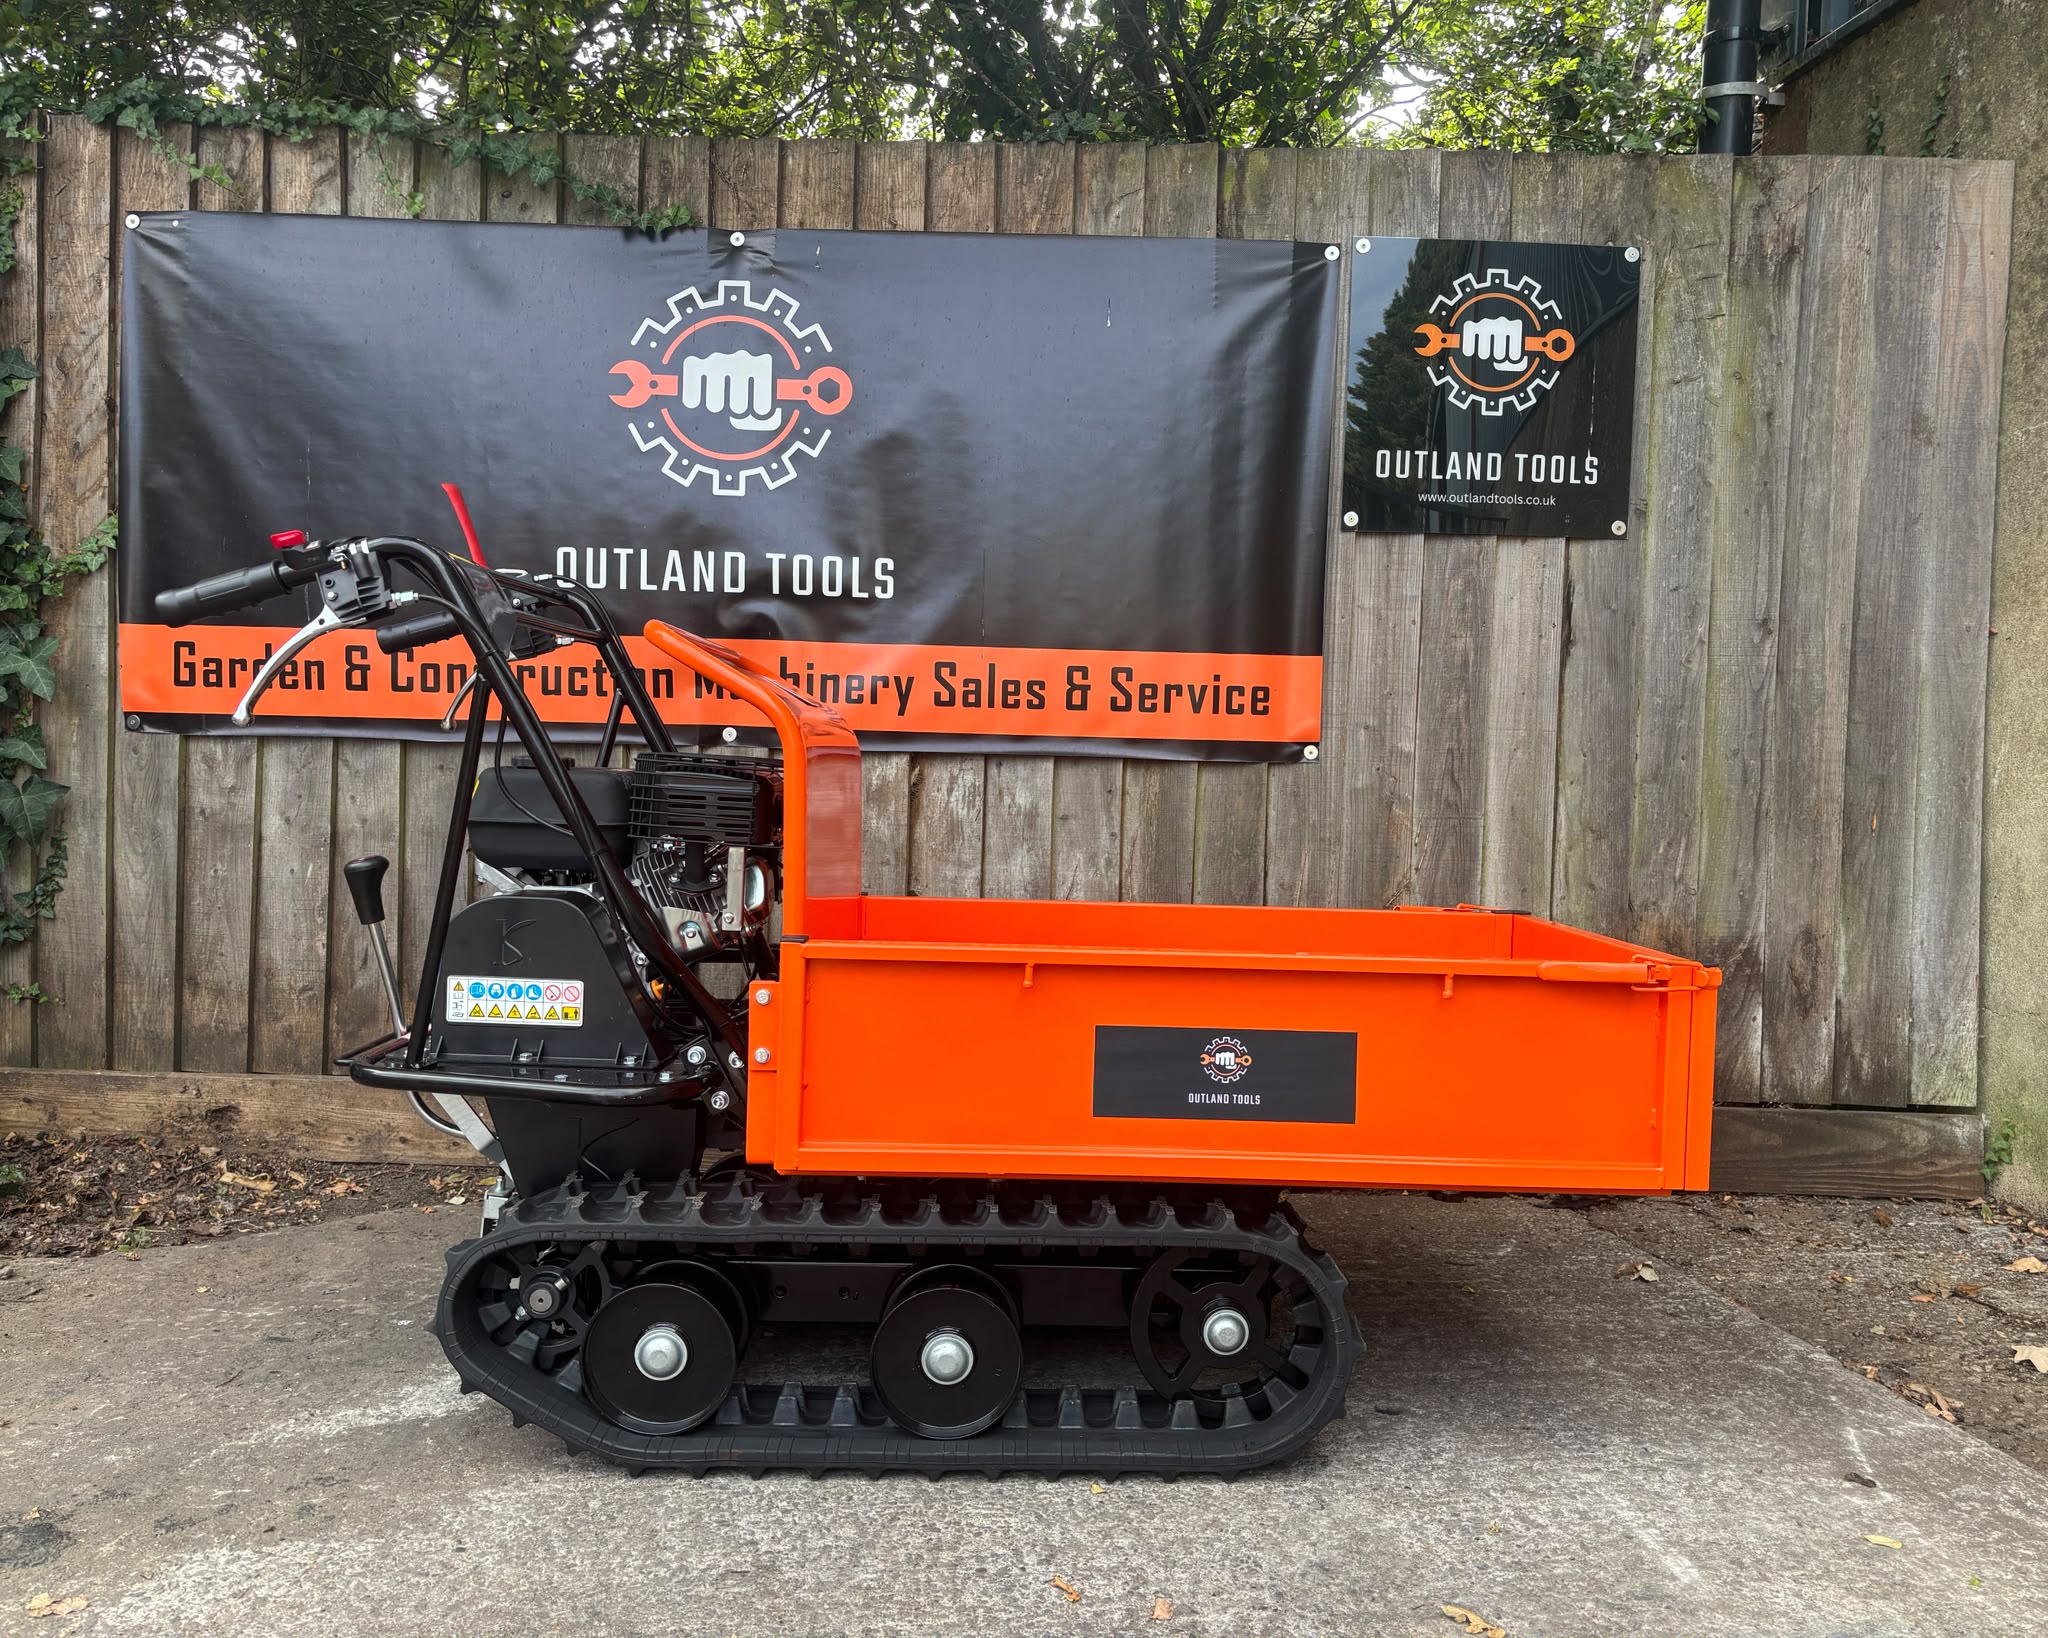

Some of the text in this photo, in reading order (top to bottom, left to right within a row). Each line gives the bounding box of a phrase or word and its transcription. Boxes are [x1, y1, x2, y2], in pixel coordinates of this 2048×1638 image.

[1375, 450, 1599, 485] OUTLAND TOOLS
[1417, 492, 1557, 506] www.outlandtools.co.uk
[556, 546, 895, 599] OUTLAND TOOLS
[173, 640, 325, 691] Garden
[345, 645, 371, 692] &
[933, 661, 1046, 710] Sales
[1065, 665, 1092, 712] &
[1109, 666, 1271, 716] Service
[1188, 1092, 1261, 1105] OUTLAND TOOLS
